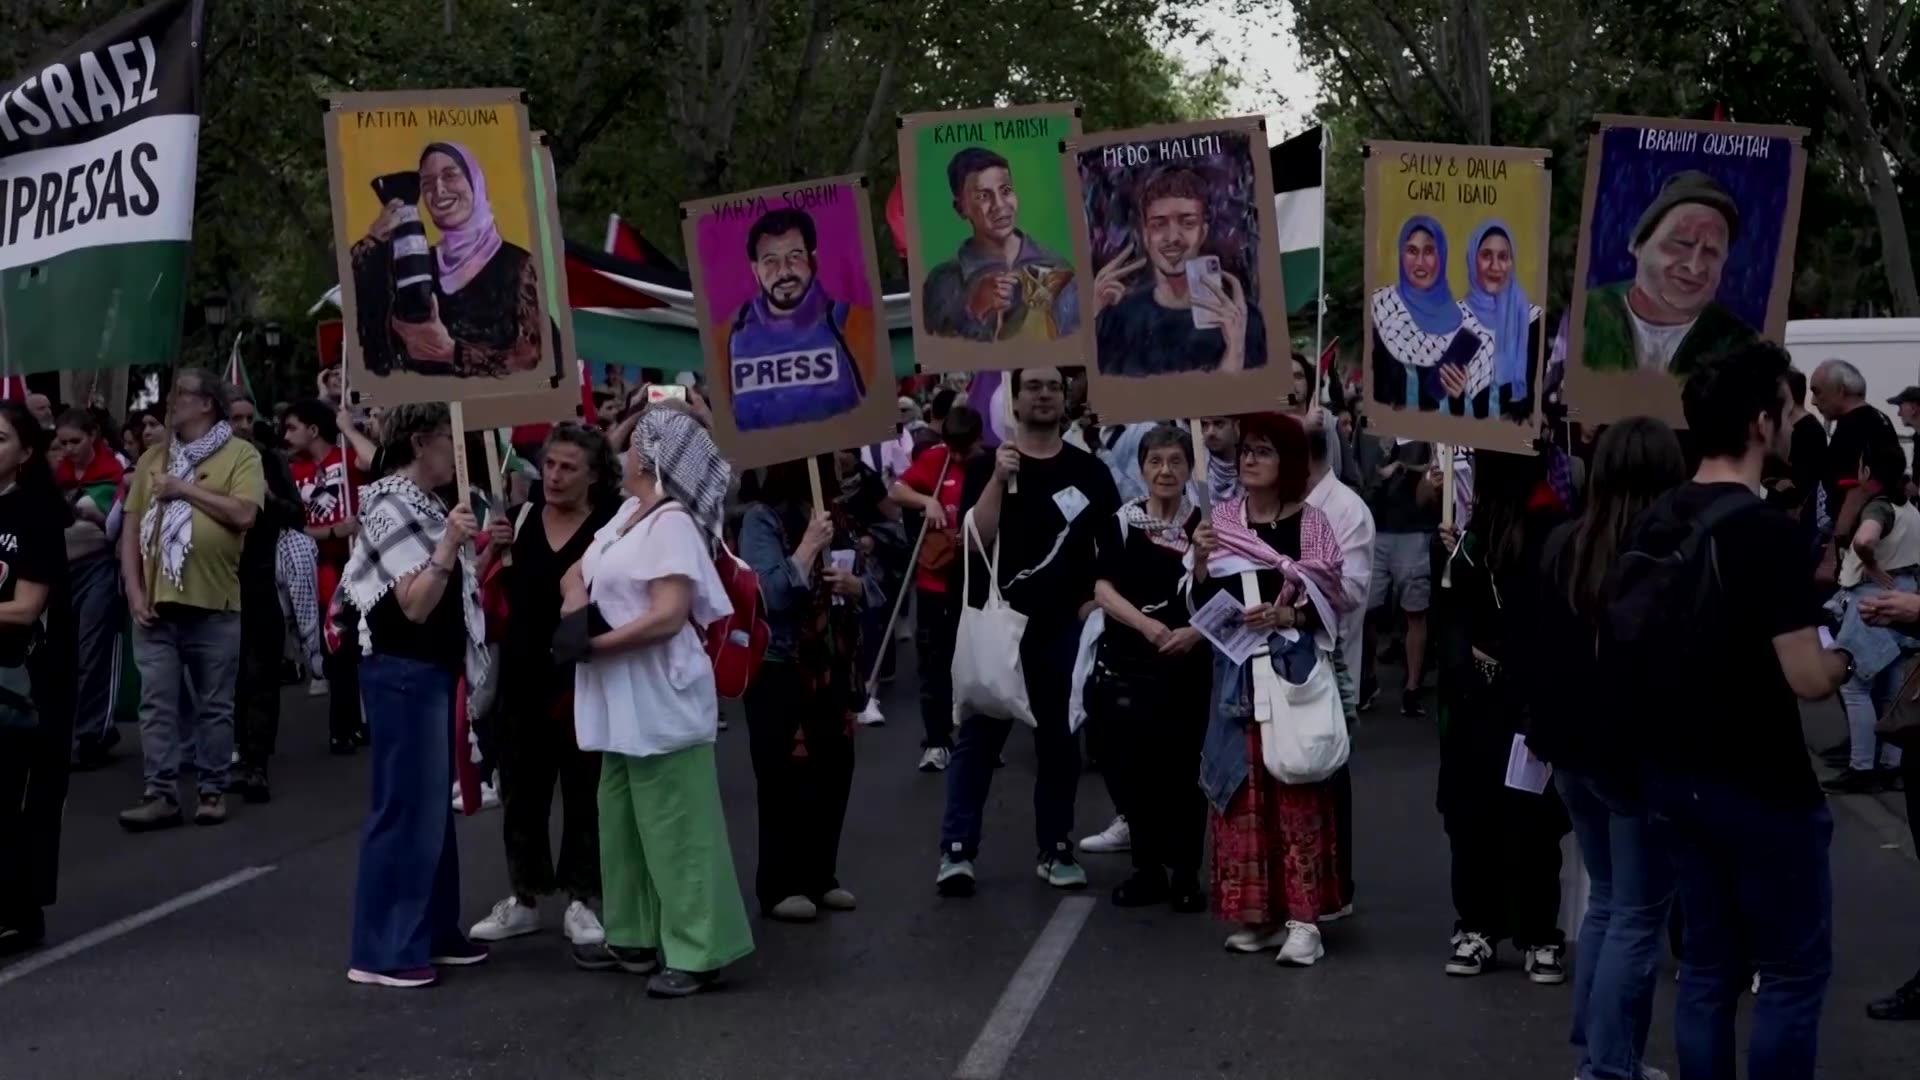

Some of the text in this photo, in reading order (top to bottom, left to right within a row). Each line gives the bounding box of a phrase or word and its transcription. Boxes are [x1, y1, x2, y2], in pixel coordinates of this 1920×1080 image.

[0, 36, 158, 141] ISRAEL
[357, 109, 499, 128] FATIMA HASOUNA
[934, 117, 1048, 144] KAMAL MARISH
[1103, 135, 1221, 167] MEDO HALIMI
[1638, 127, 1698, 155] IBRAHIM
[1400, 152, 1442, 176] SALLY
[1447, 156, 1459, 177] &
[1407, 179, 1497, 205] GHAZI IBAID
[712, 195, 768, 224] YAHYA
[734, 352, 833, 390] PRESS
